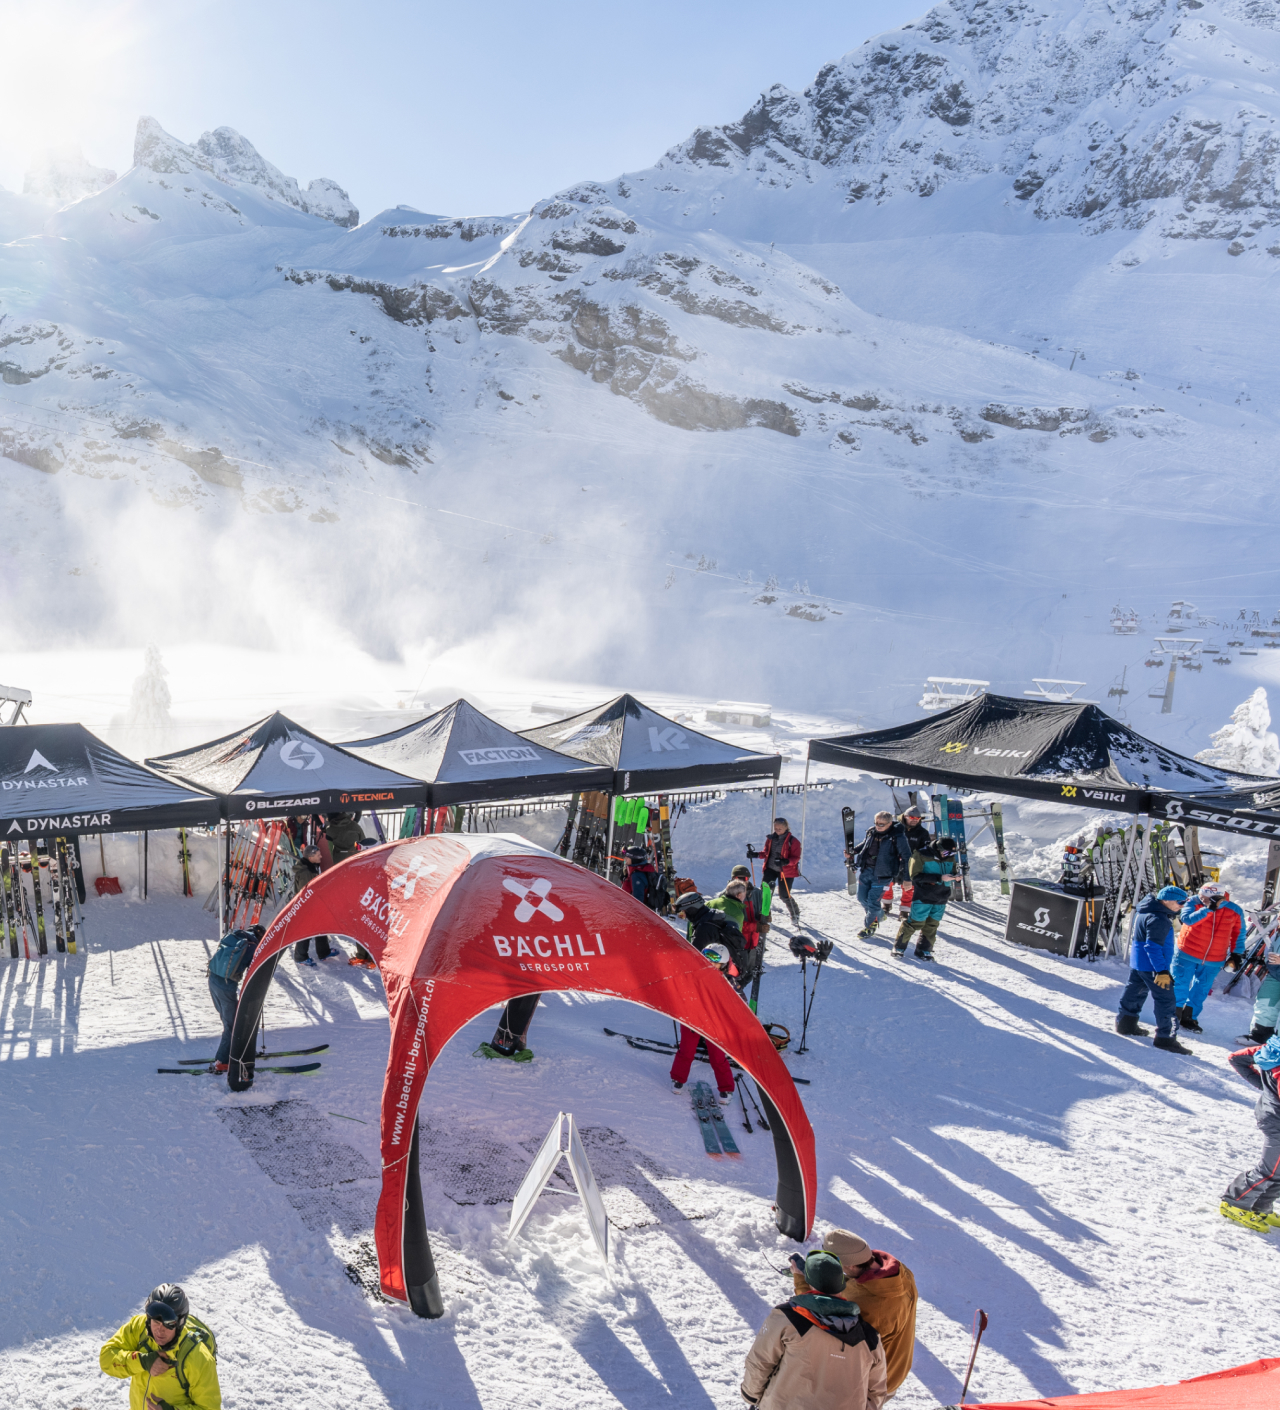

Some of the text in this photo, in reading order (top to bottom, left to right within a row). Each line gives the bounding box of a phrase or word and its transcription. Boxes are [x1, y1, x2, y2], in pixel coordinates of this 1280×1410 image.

[648, 727, 690, 751] K2
[464, 747, 537, 763] FACTION
[2, 777, 89, 790] DYNASTAR
[257, 797, 320, 809] BLIZZARD
[351, 792, 394, 802] TECNICA
[27, 814, 111, 831] DYNASTAR
[359, 887, 410, 938] BÄCHLI
[1016, 922, 1063, 940] SCOTT
[493, 934, 606, 957] BÄCHLI
[519, 963, 590, 972] BERGSPORT
[391, 979, 436, 1146] www.baechli-bergsport.ch
